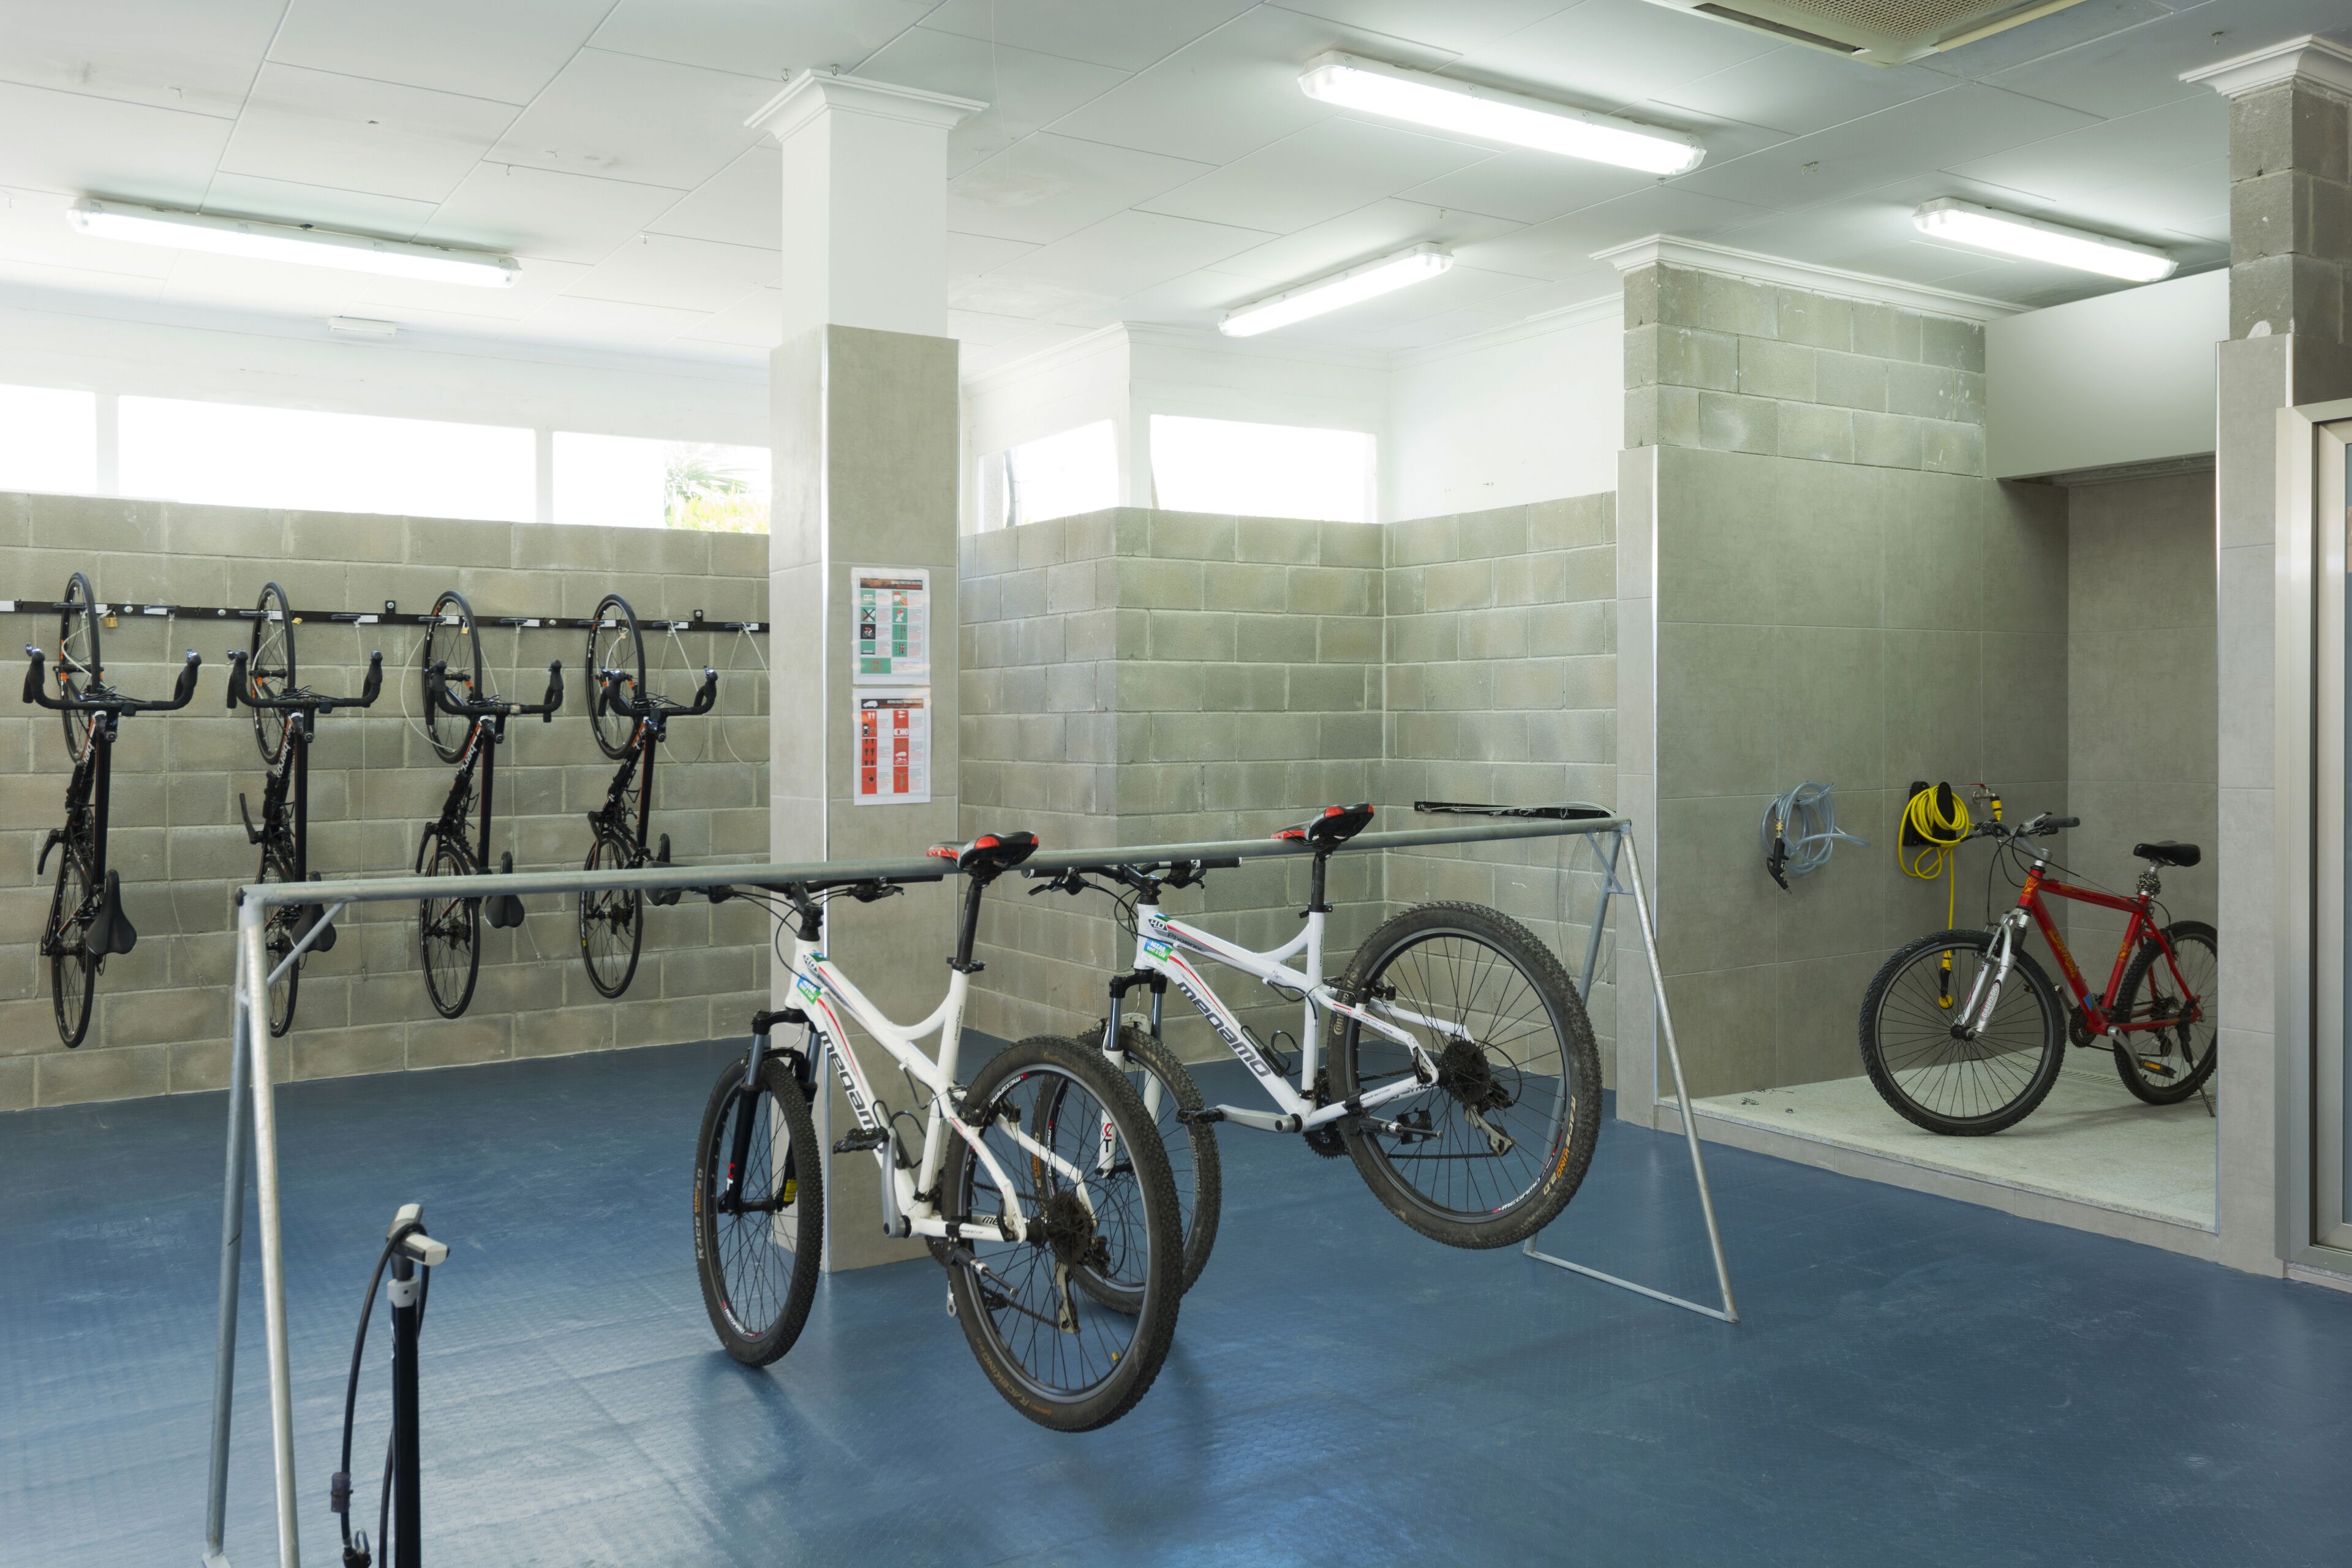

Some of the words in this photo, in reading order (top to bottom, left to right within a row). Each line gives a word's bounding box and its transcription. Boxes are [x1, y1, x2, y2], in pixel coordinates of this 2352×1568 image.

[1150, 919, 1166, 929] 4.0
[1167, 932, 1203, 951] Phoenix
[1177, 982, 1272, 1077] megamo
[1566, 1095, 1577, 1148] RACE
[1556, 1147, 1570, 1179] KING
[1543, 1171, 1557, 1196] 2.0
[695, 1216, 706, 1259] RACE
